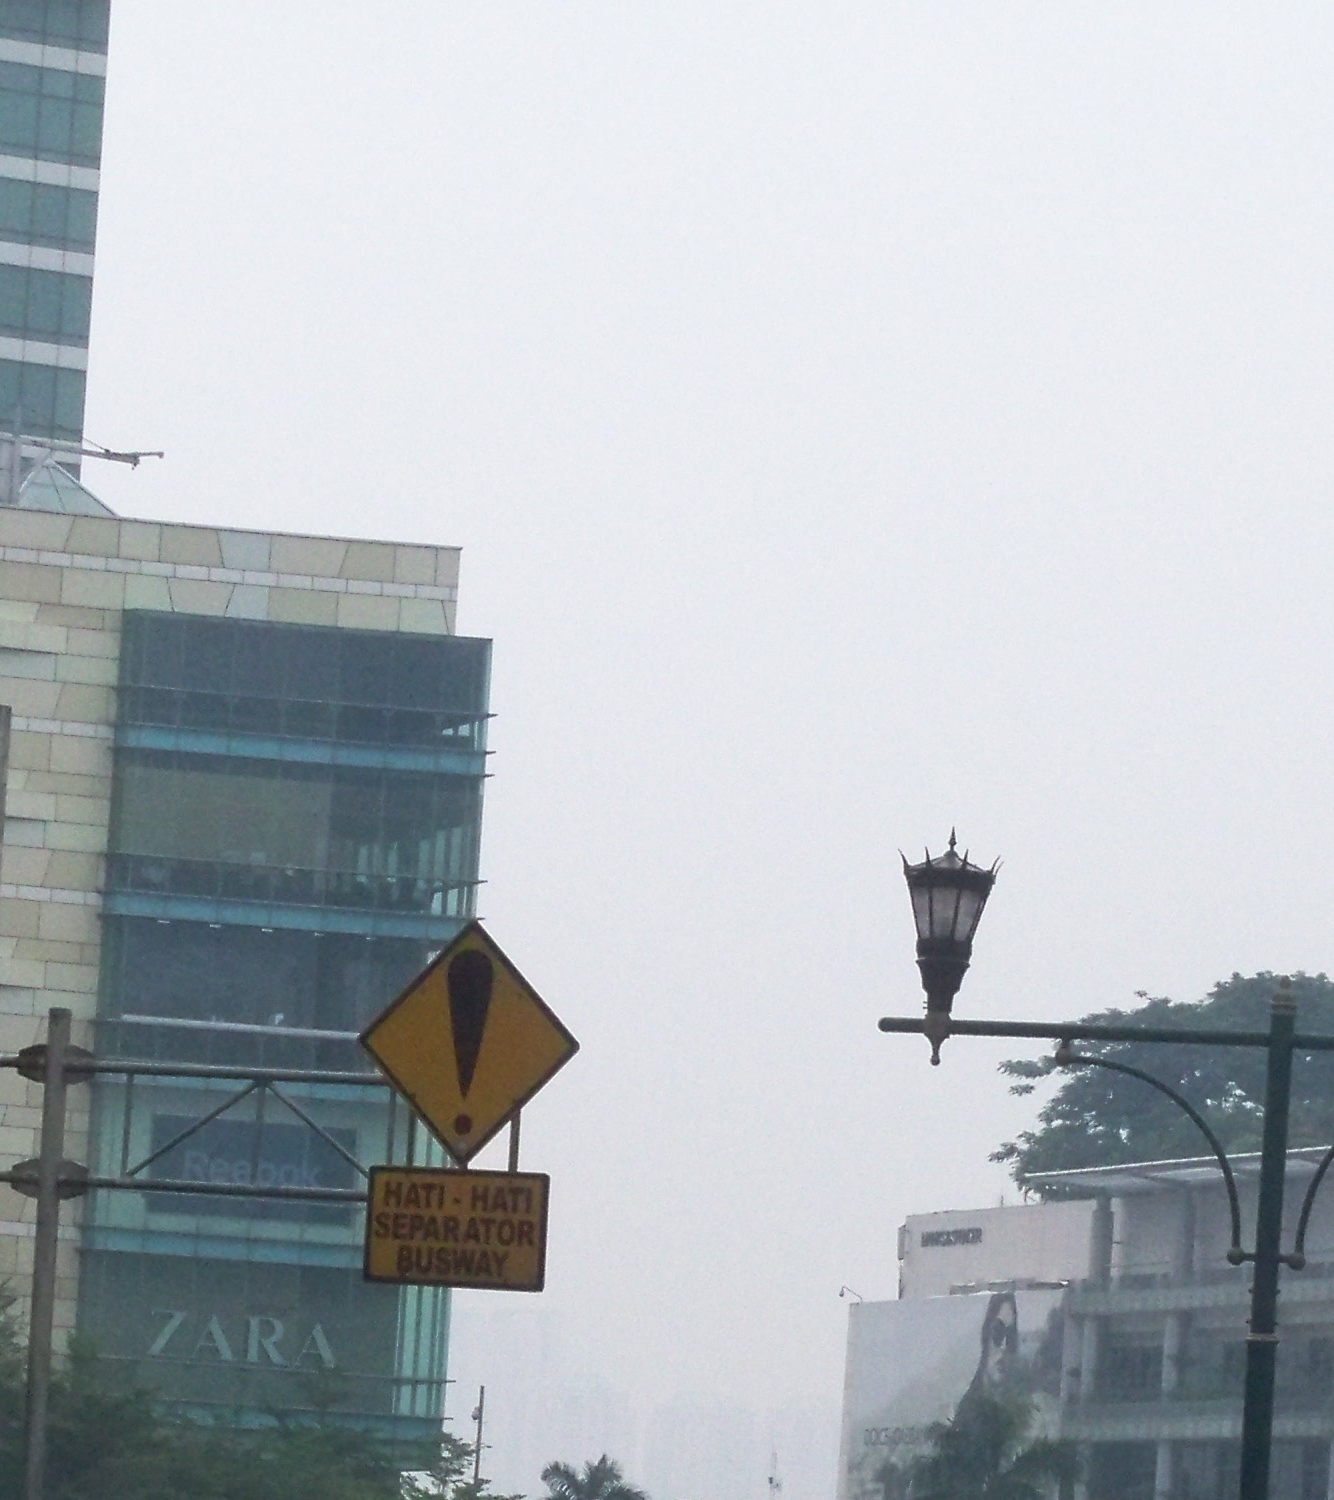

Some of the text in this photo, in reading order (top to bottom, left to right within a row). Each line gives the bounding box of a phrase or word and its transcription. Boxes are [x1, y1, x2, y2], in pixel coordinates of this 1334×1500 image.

[382, 1180, 446, 1210] HATI
[471, 1184, 533, 1215] HATI
[374, 1211, 536, 1247] SEPARATOR
[396, 1244, 510, 1278] BUSWAY
[146, 1309, 337, 1368] ZARA
